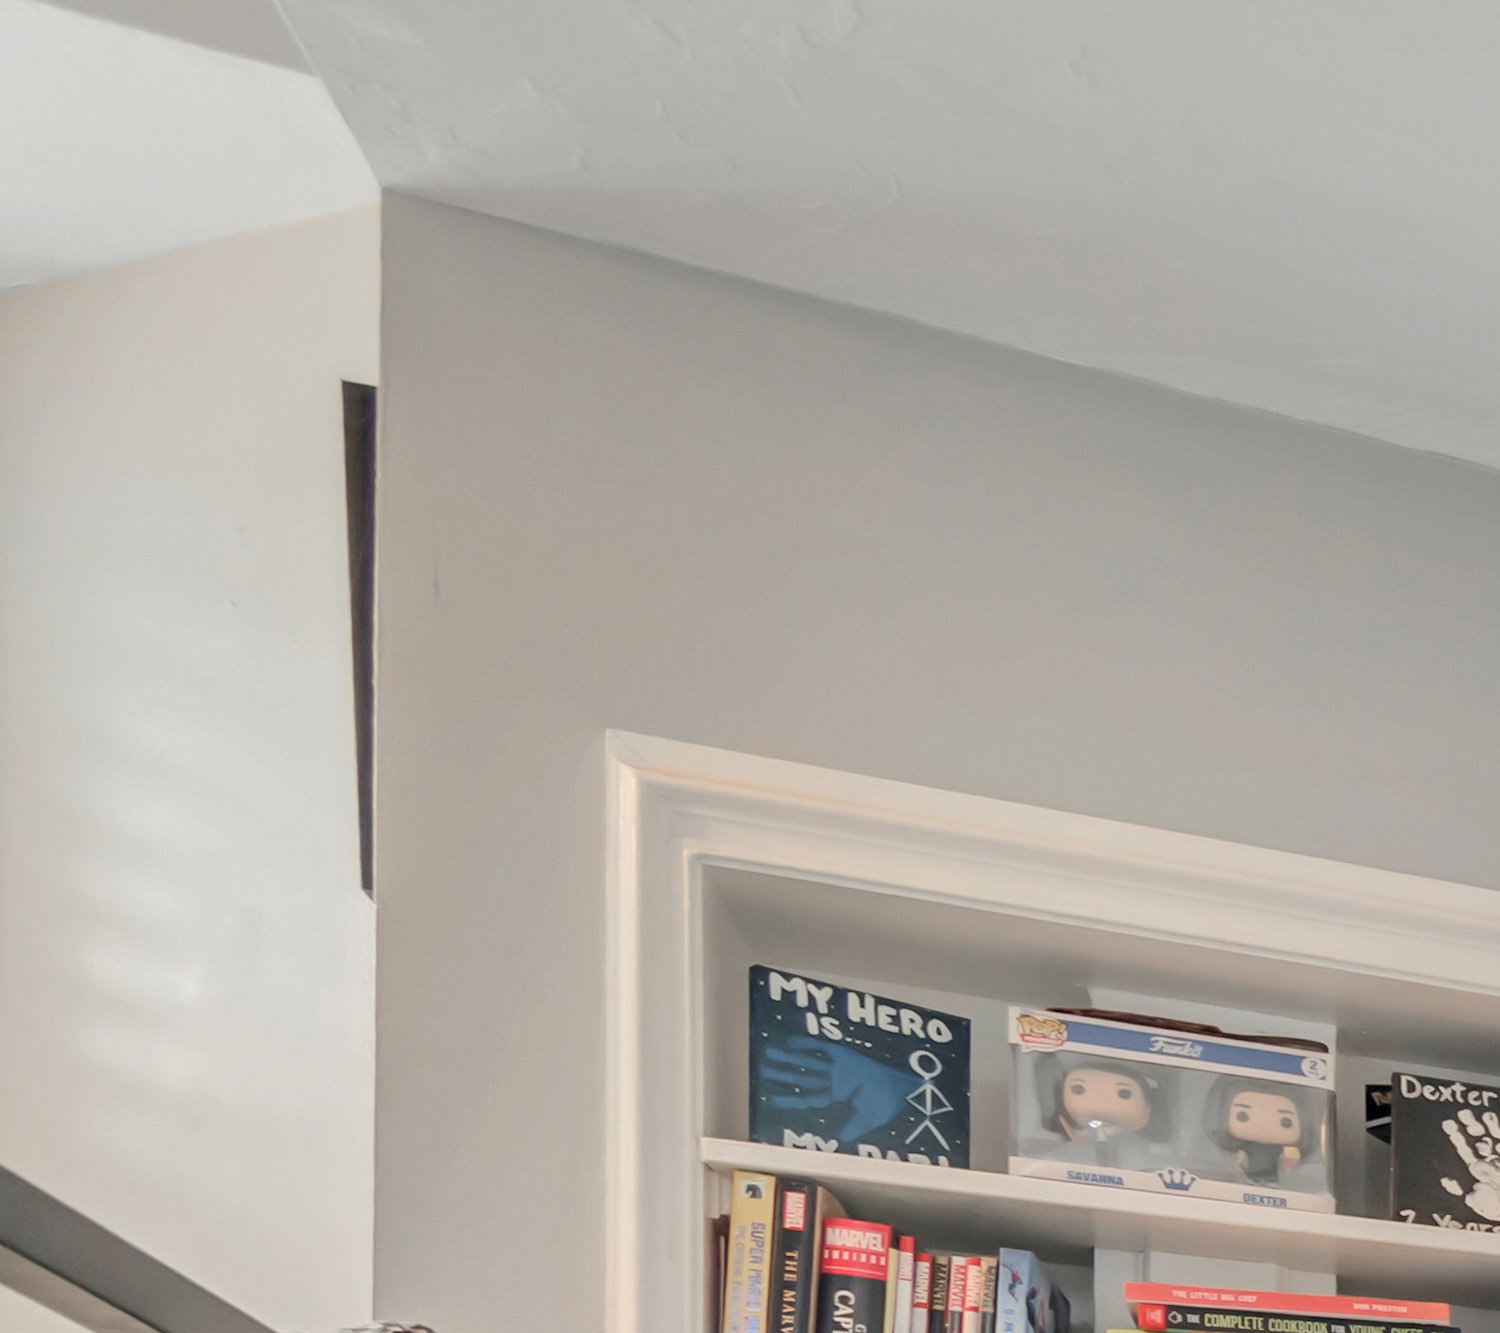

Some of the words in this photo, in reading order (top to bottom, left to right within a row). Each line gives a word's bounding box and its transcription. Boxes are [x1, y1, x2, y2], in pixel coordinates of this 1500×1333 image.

[769, 971, 833, 1014] MY
[847, 991, 953, 1043] HERO
[805, 1011, 873, 1048] IS...
[1150, 1035, 1204, 1058] Funko
[1309, 1059, 1318, 1070] 2
[1400, 1075, 1498, 1107] Dexter
[1067, 1169, 1125, 1187] SAVANNA
[1243, 1192, 1288, 1208] DEXTER
[749, 1222, 766, 1264] SUPER
[826, 1226, 885, 1252] MARVEL
[784, 1251, 799, 1281] THE
[932, 1263, 947, 1307] MARVEL
[950, 1264, 966, 1310] MARVEL
[1204, 1315, 1264, 1331] COMPLETE
